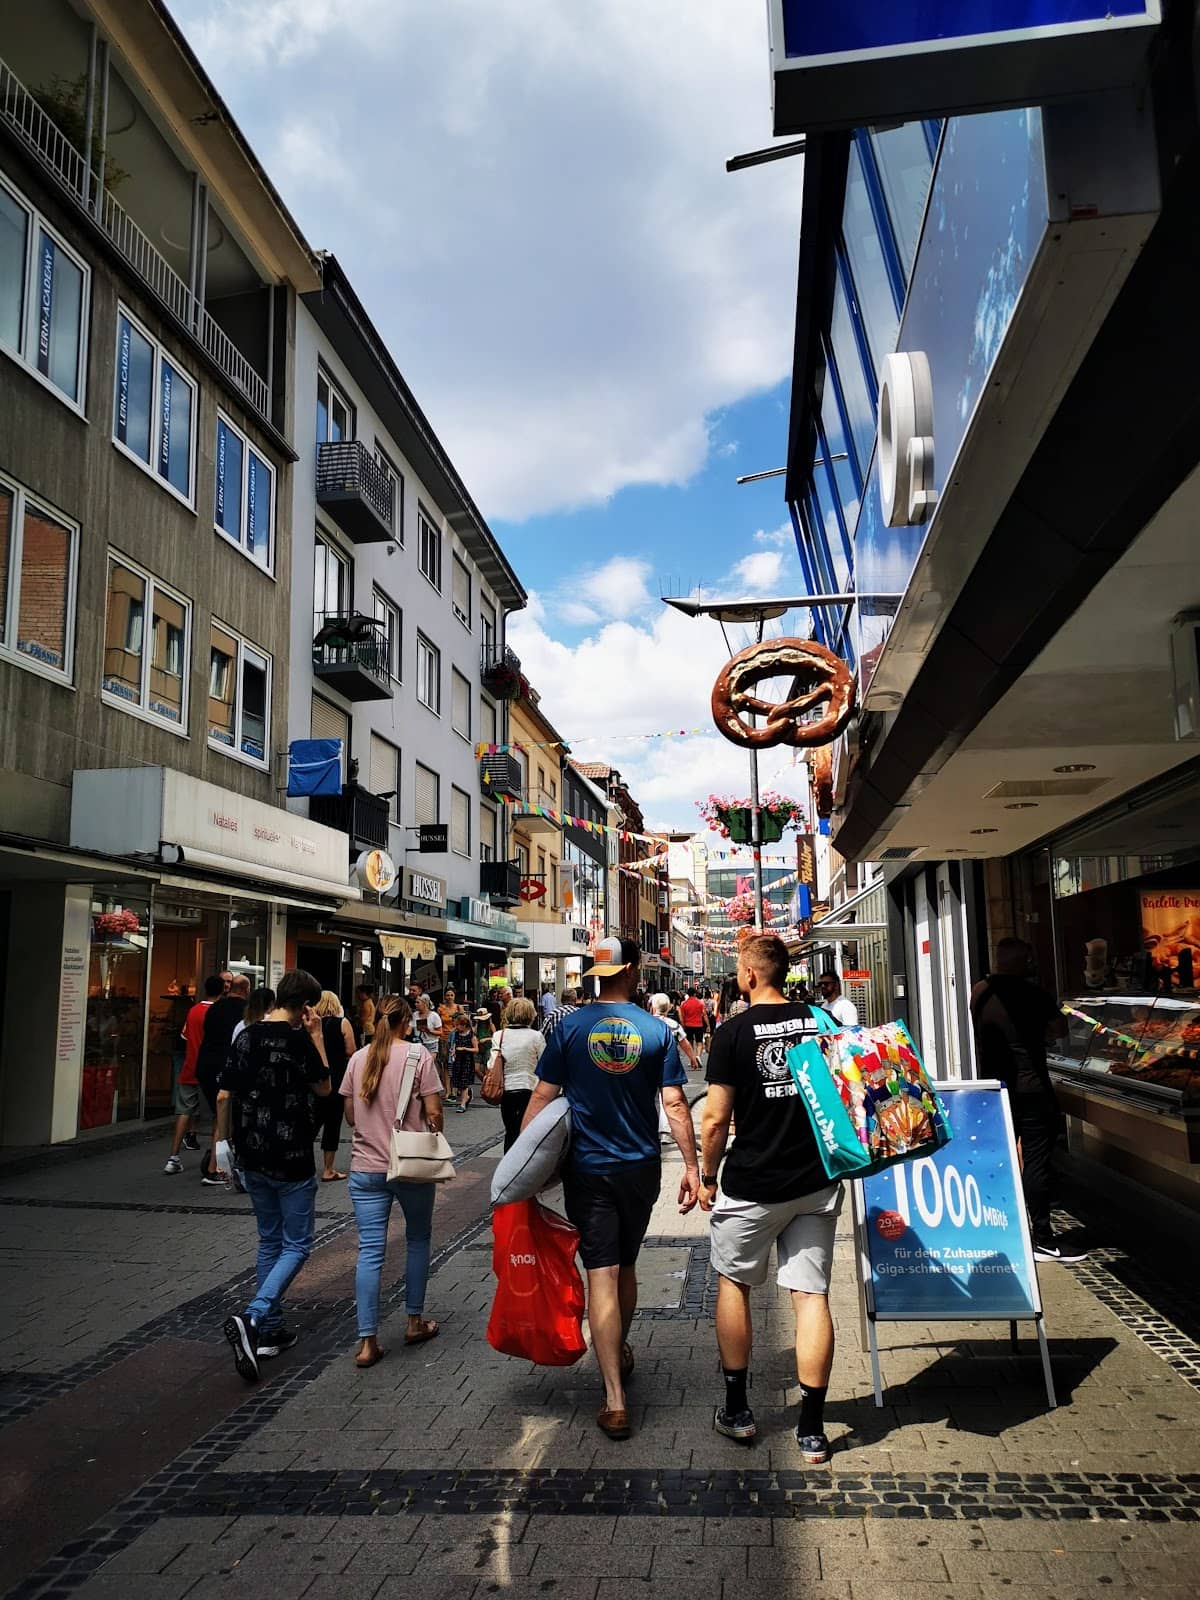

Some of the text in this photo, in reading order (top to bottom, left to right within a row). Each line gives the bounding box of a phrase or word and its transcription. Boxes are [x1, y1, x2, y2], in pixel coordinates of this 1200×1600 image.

[39, 249, 54, 357] LERN-ACADEMY
[119, 329, 131, 426] LERN-ACADEMY
[161, 373, 171, 464] LERN-ACADEMY
[217, 431, 226, 513] LERN-ACADEMY
[412, 874, 443, 903] HUSSEL
[753, 1018, 804, 1036] RAMSTEIN
[893, 1156, 982, 1228] 1000
[876, 1263, 964, 1277] Giga-schnelles
[894, 1247, 998, 1258] für dein Zuhause:
